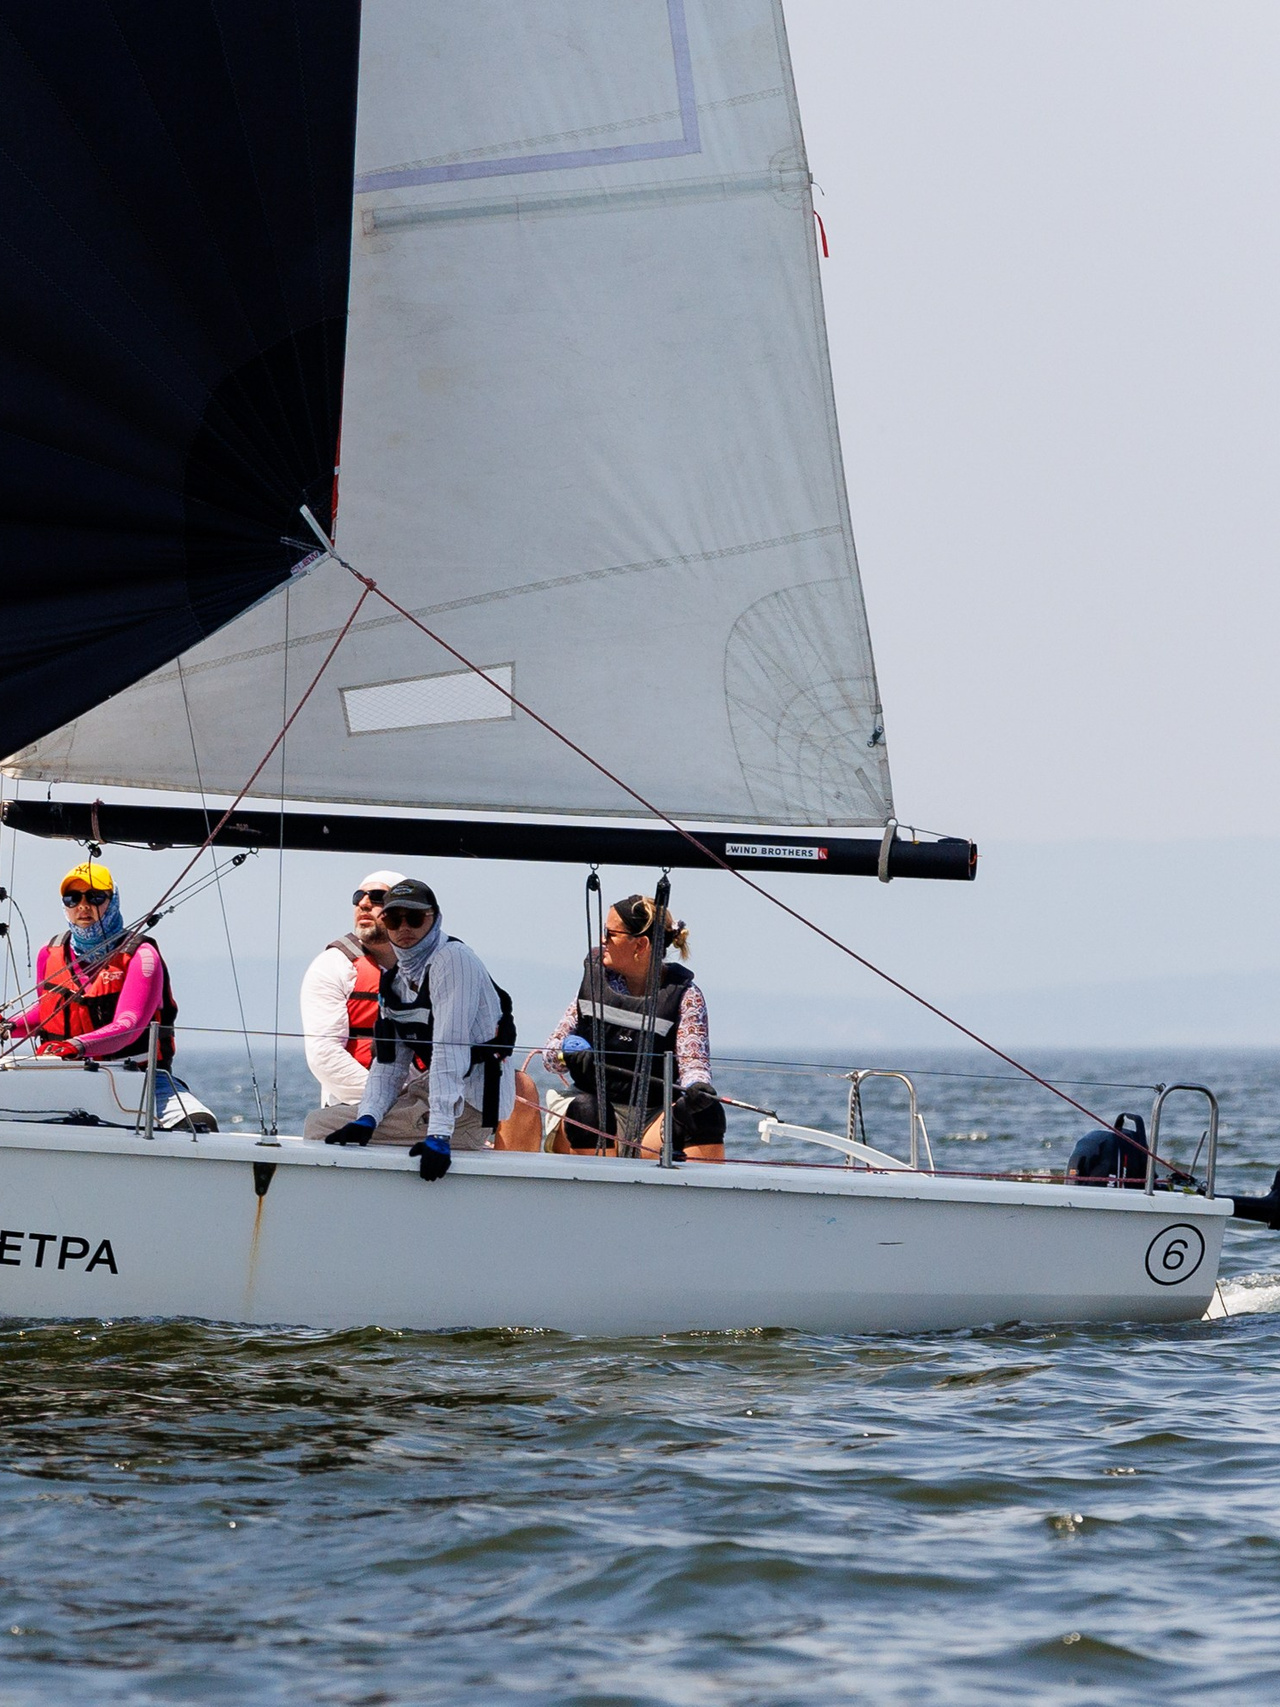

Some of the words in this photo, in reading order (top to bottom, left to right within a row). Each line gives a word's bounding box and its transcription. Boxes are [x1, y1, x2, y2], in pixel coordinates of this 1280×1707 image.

[730, 845, 758, 855] WIND
[761, 847, 814, 857] BROTHERS
[1162, 1238, 1189, 1271] 6
